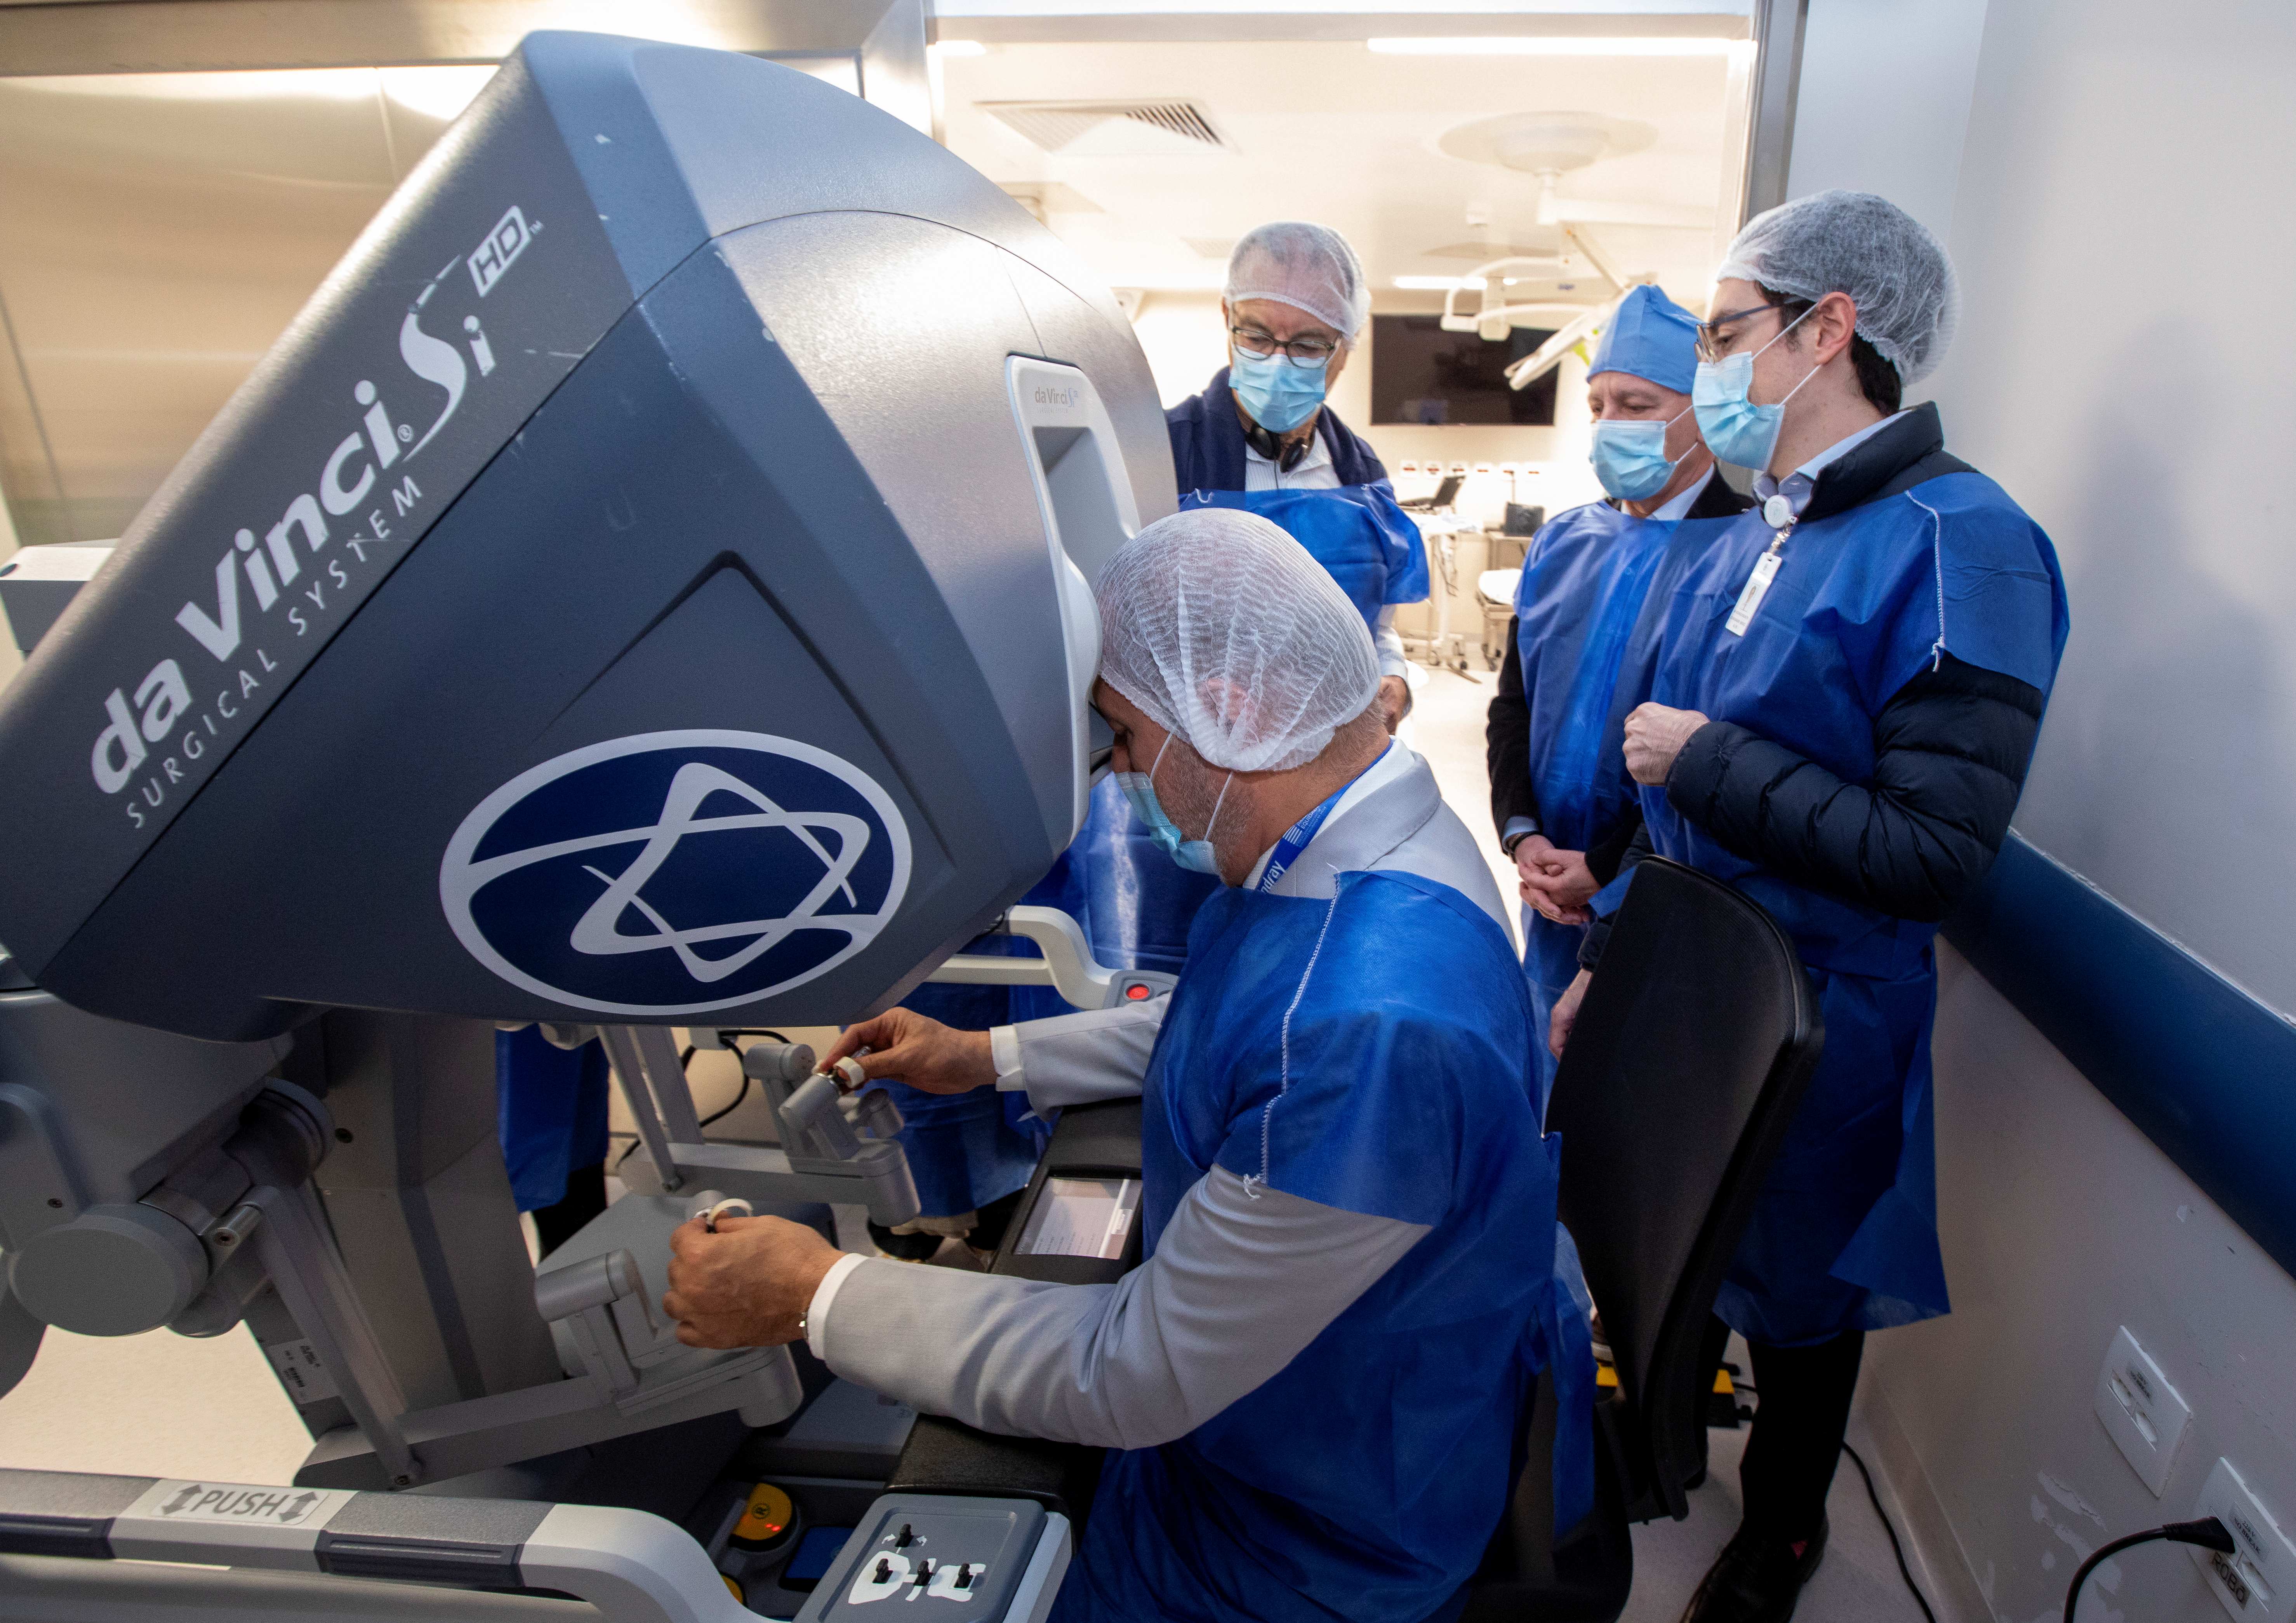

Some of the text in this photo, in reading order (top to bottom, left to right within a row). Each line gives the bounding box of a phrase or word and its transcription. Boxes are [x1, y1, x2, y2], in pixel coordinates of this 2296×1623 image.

[1035, 387, 1046, 403] da
[127, 475, 422, 828] SURGICAL SYSTEM
[92, 659, 193, 794] da
[1301, 806, 1319, 829] EQUIDAD
[1259, 860, 1285, 893] ndray
[189, 1490, 290, 1517] PUSH
[2234, 1517, 2260, 1554] NO BREAK
[2242, 1520, 2252, 1532] 220
